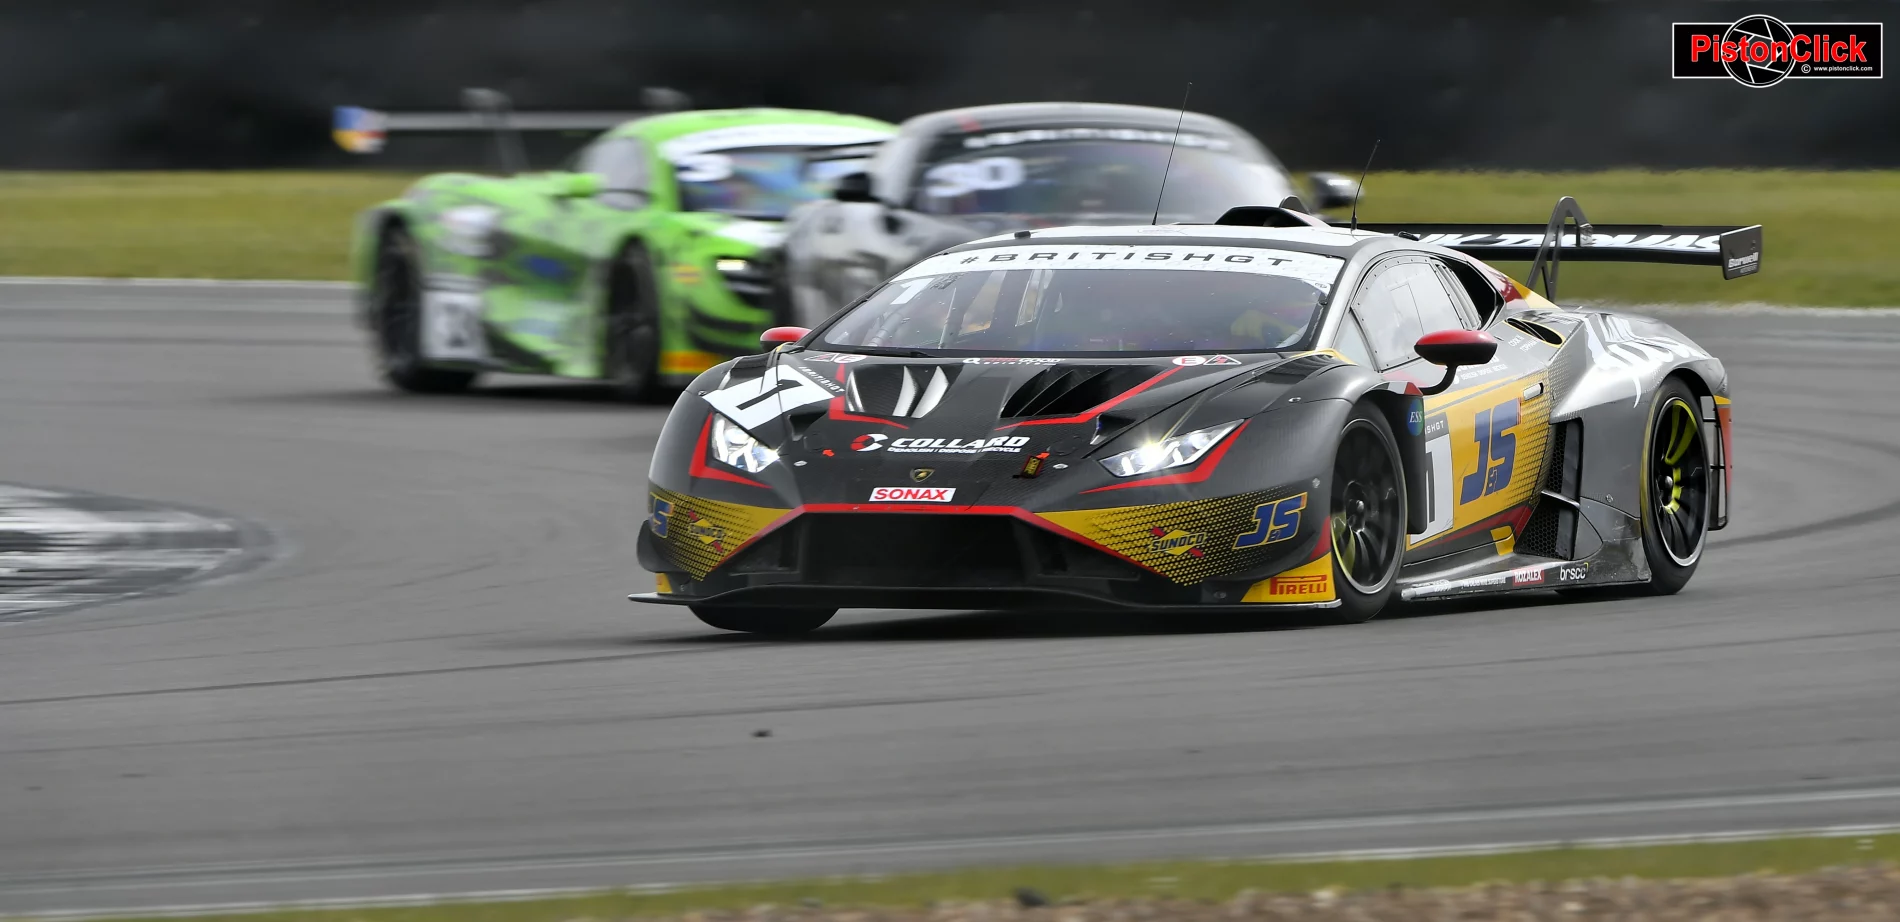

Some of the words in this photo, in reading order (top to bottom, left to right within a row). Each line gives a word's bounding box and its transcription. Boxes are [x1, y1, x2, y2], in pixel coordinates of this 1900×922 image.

[736, 378, 804, 411] 1
[890, 436, 1031, 449] COLLARD
[1459, 396, 1522, 506] JS
[874, 488, 950, 501] SONAX
[1232, 492, 1308, 551] JS
[1150, 531, 1207, 551] SUNOCO
[1269, 574, 1327, 595] PIRELLI
[1513, 569, 1543, 583] ROZALEX
